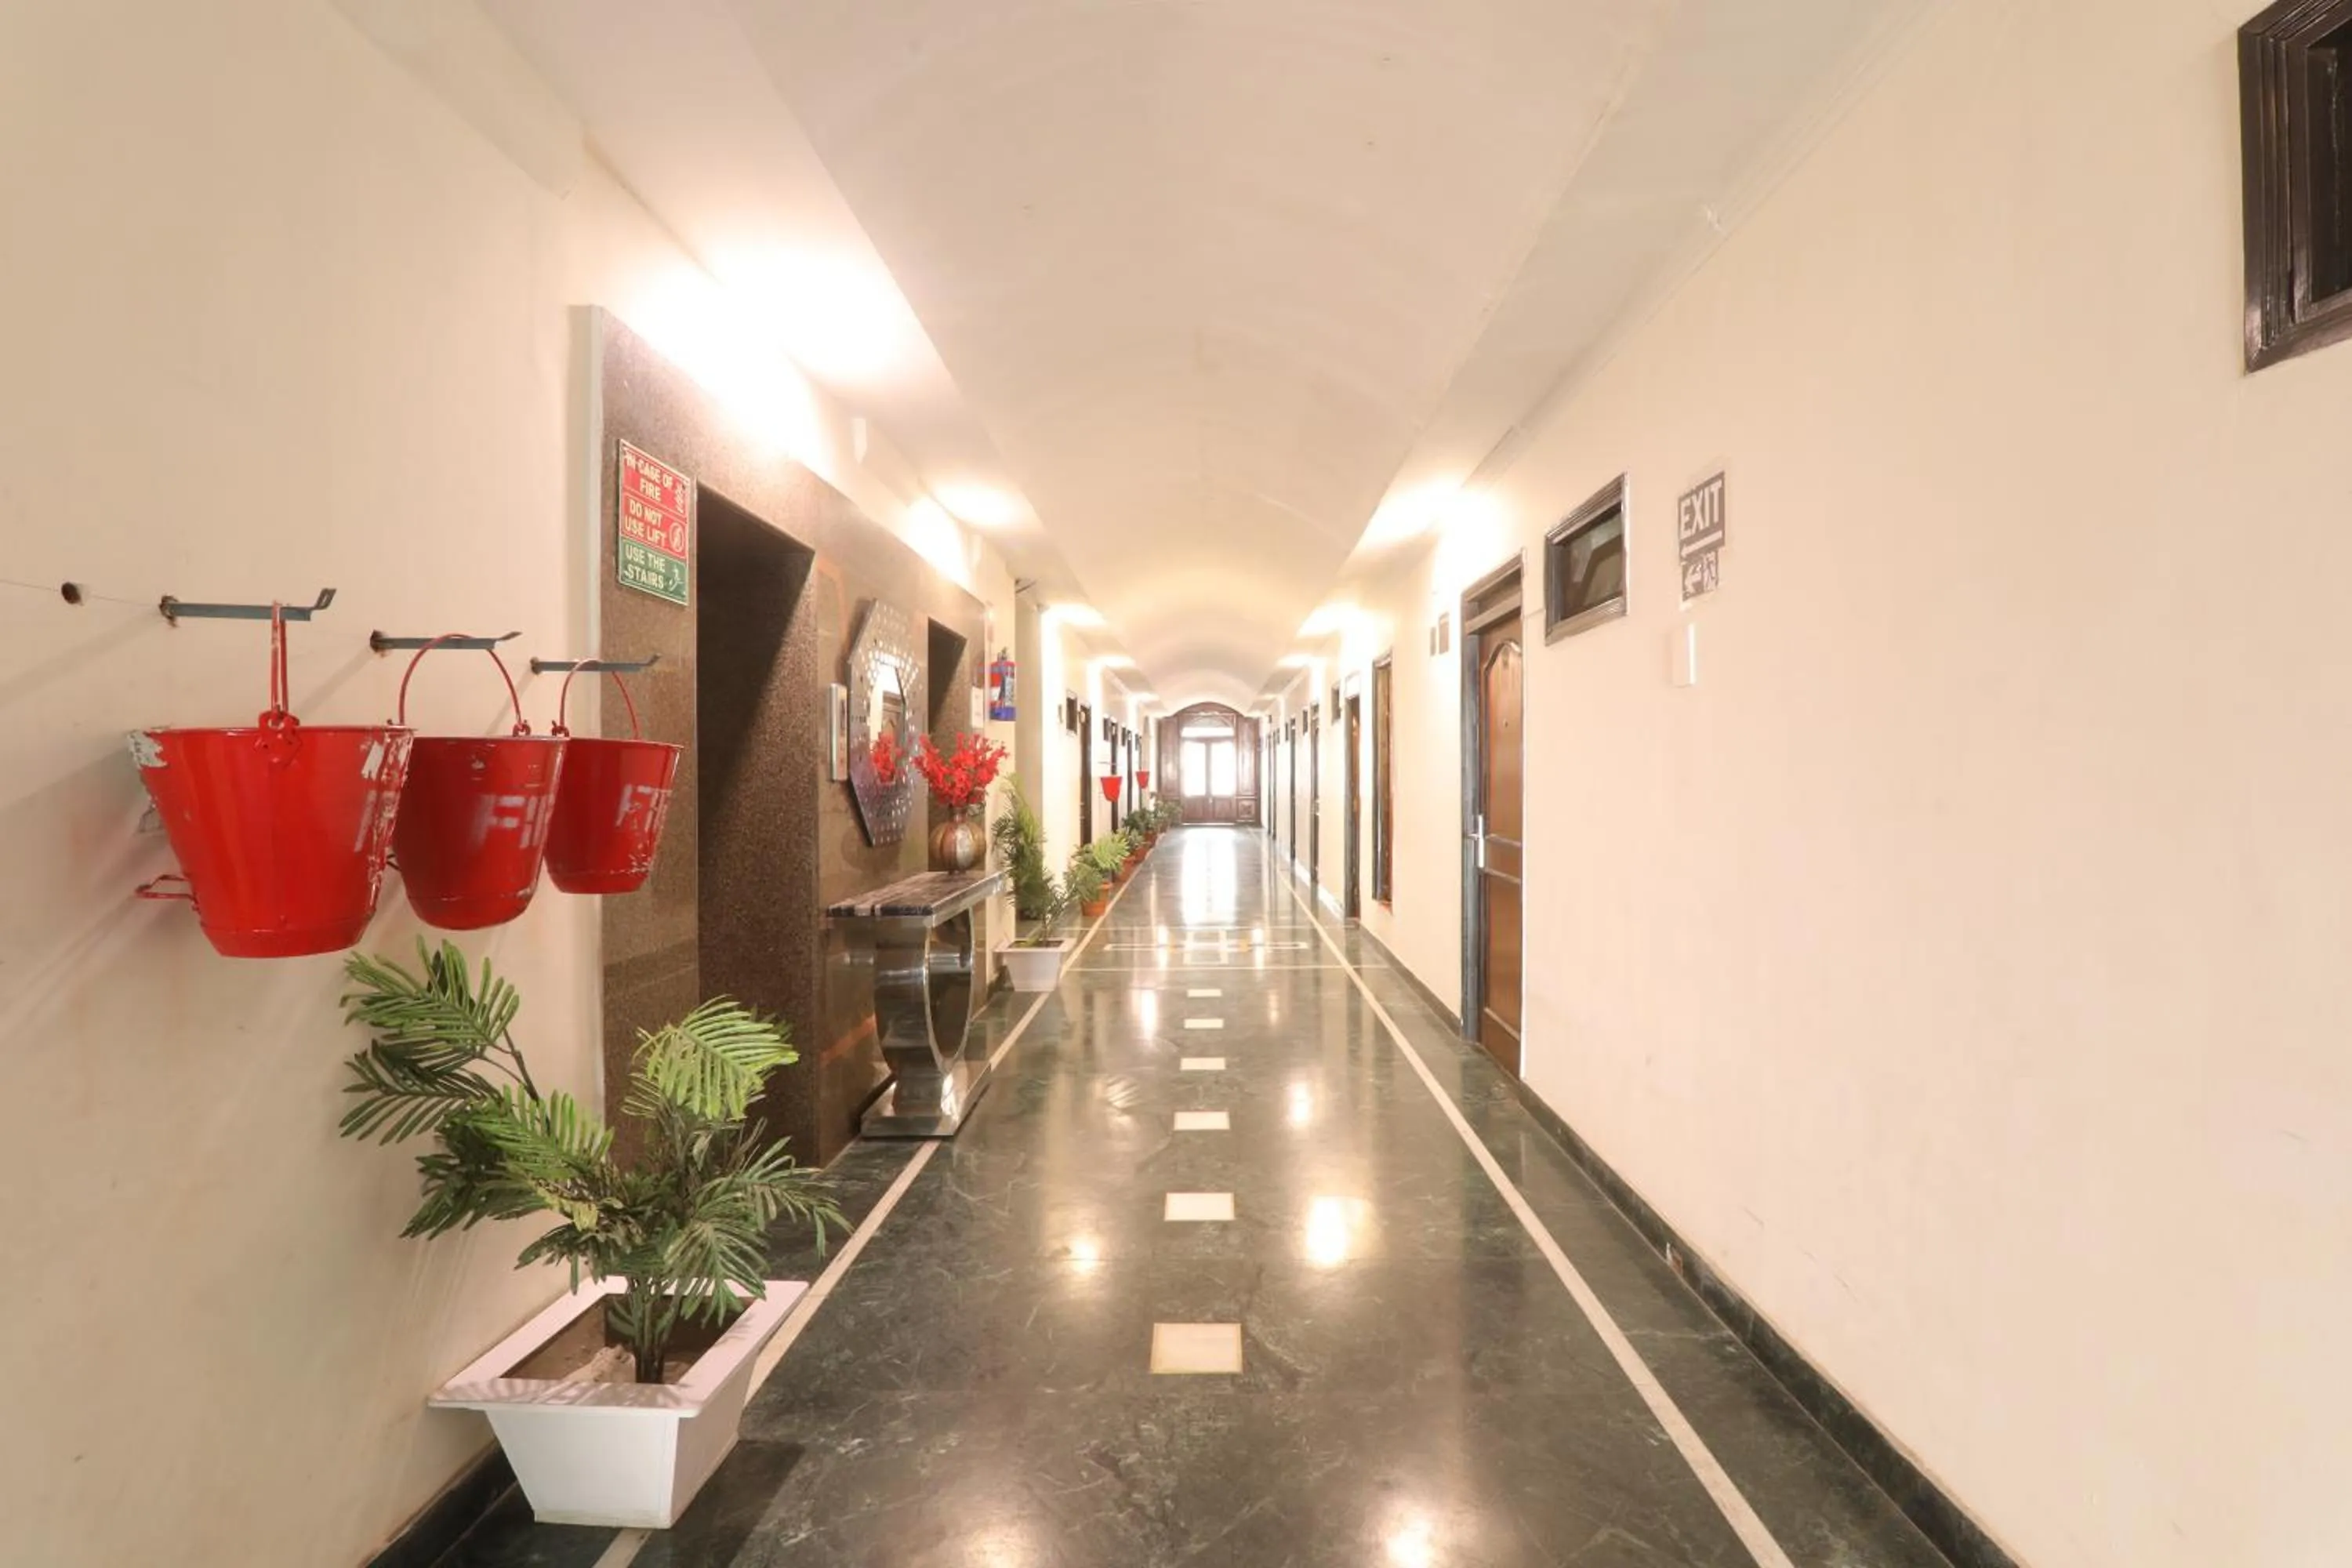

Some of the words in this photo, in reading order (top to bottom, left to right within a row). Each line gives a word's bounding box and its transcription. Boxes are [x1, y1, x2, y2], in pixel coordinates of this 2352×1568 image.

[626, 452, 636, 470] IN
[637, 459, 661, 483] CASE
[662, 473, 673, 489] OF
[640, 477, 661, 501] FIRE
[630, 499, 642, 518] DO
[644, 506, 662, 528] NOT
[1680, 480, 1723, 541] EXIT
[625, 515, 644, 537] USE
[647, 525, 666, 547] LIFT
[626, 543, 644, 564] USE
[648, 552, 665, 572] THE
[626, 564, 664, 590] STAIRS
